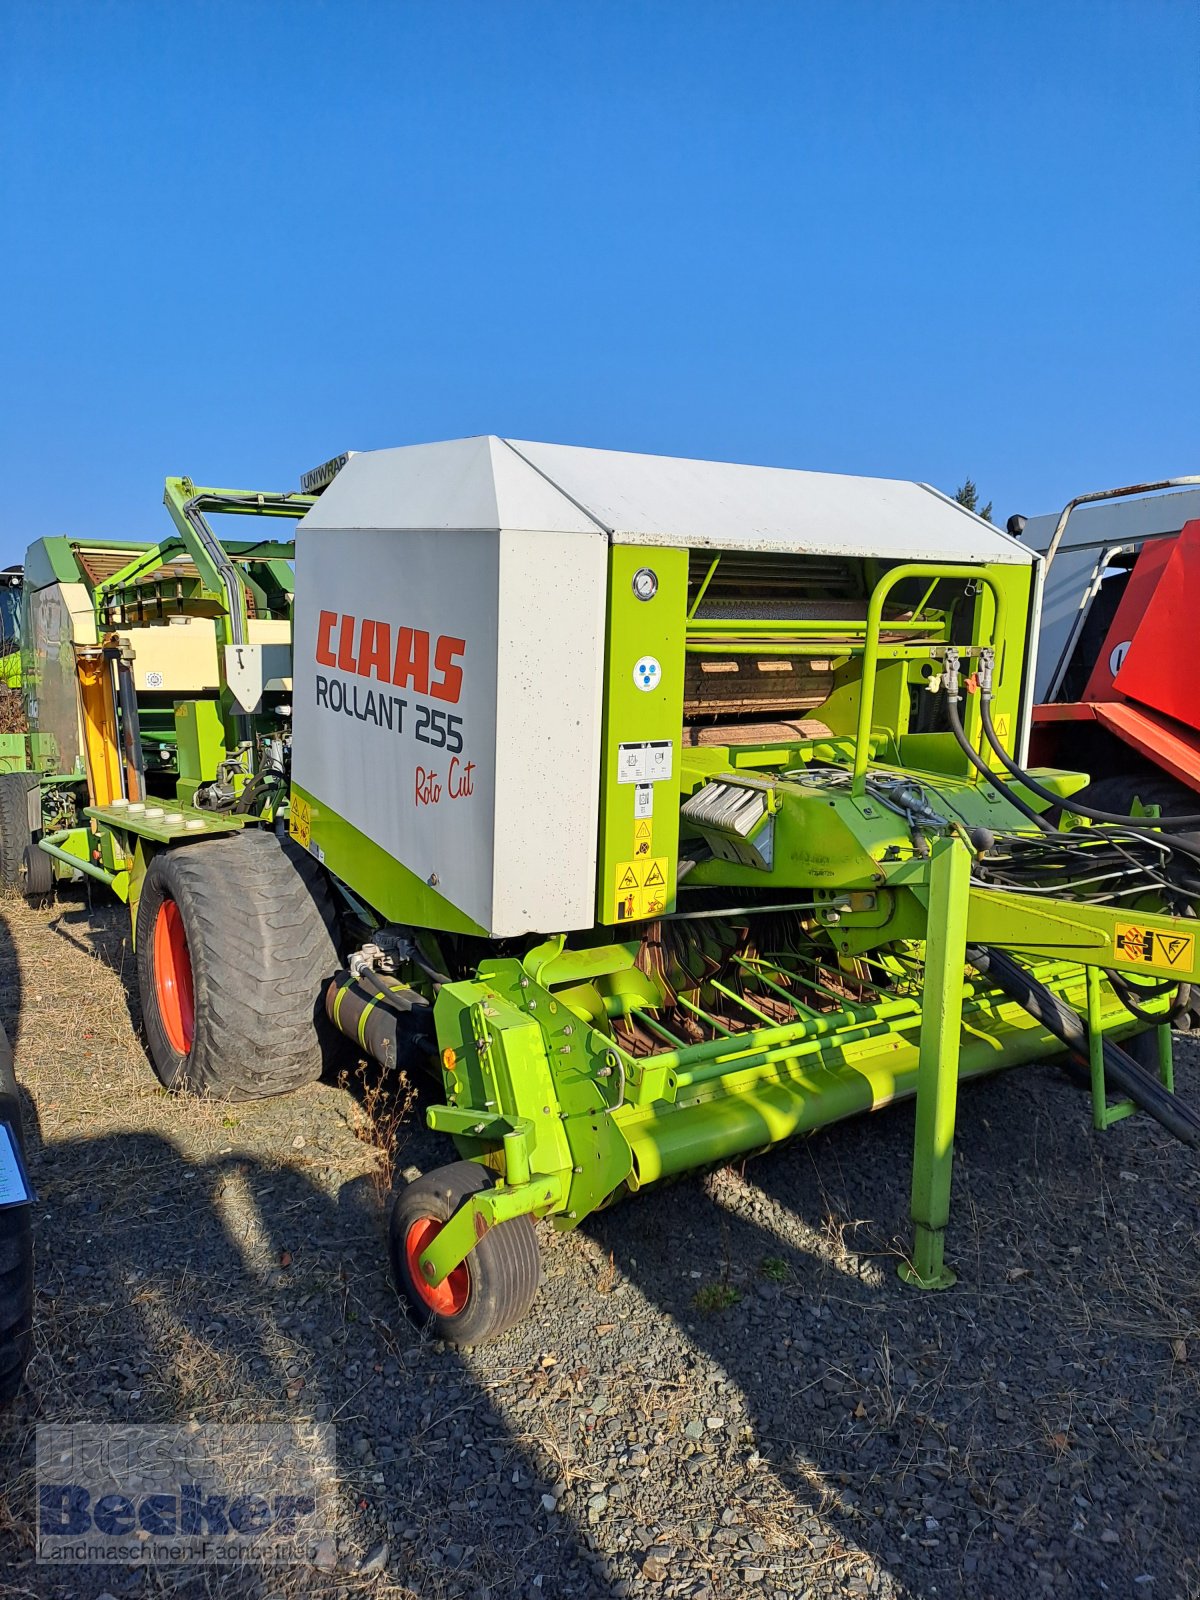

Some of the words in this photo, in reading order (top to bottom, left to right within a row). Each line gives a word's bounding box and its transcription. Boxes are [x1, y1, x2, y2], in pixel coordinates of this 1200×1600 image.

[303, 456, 347, 489] UNIWRAP
[316, 610, 466, 704] CLAAS
[316, 675, 408, 734] ROLLANT
[415, 704, 464, 754] 255
[415, 766, 443, 807] Roto
[448, 756, 476, 799] Cut
